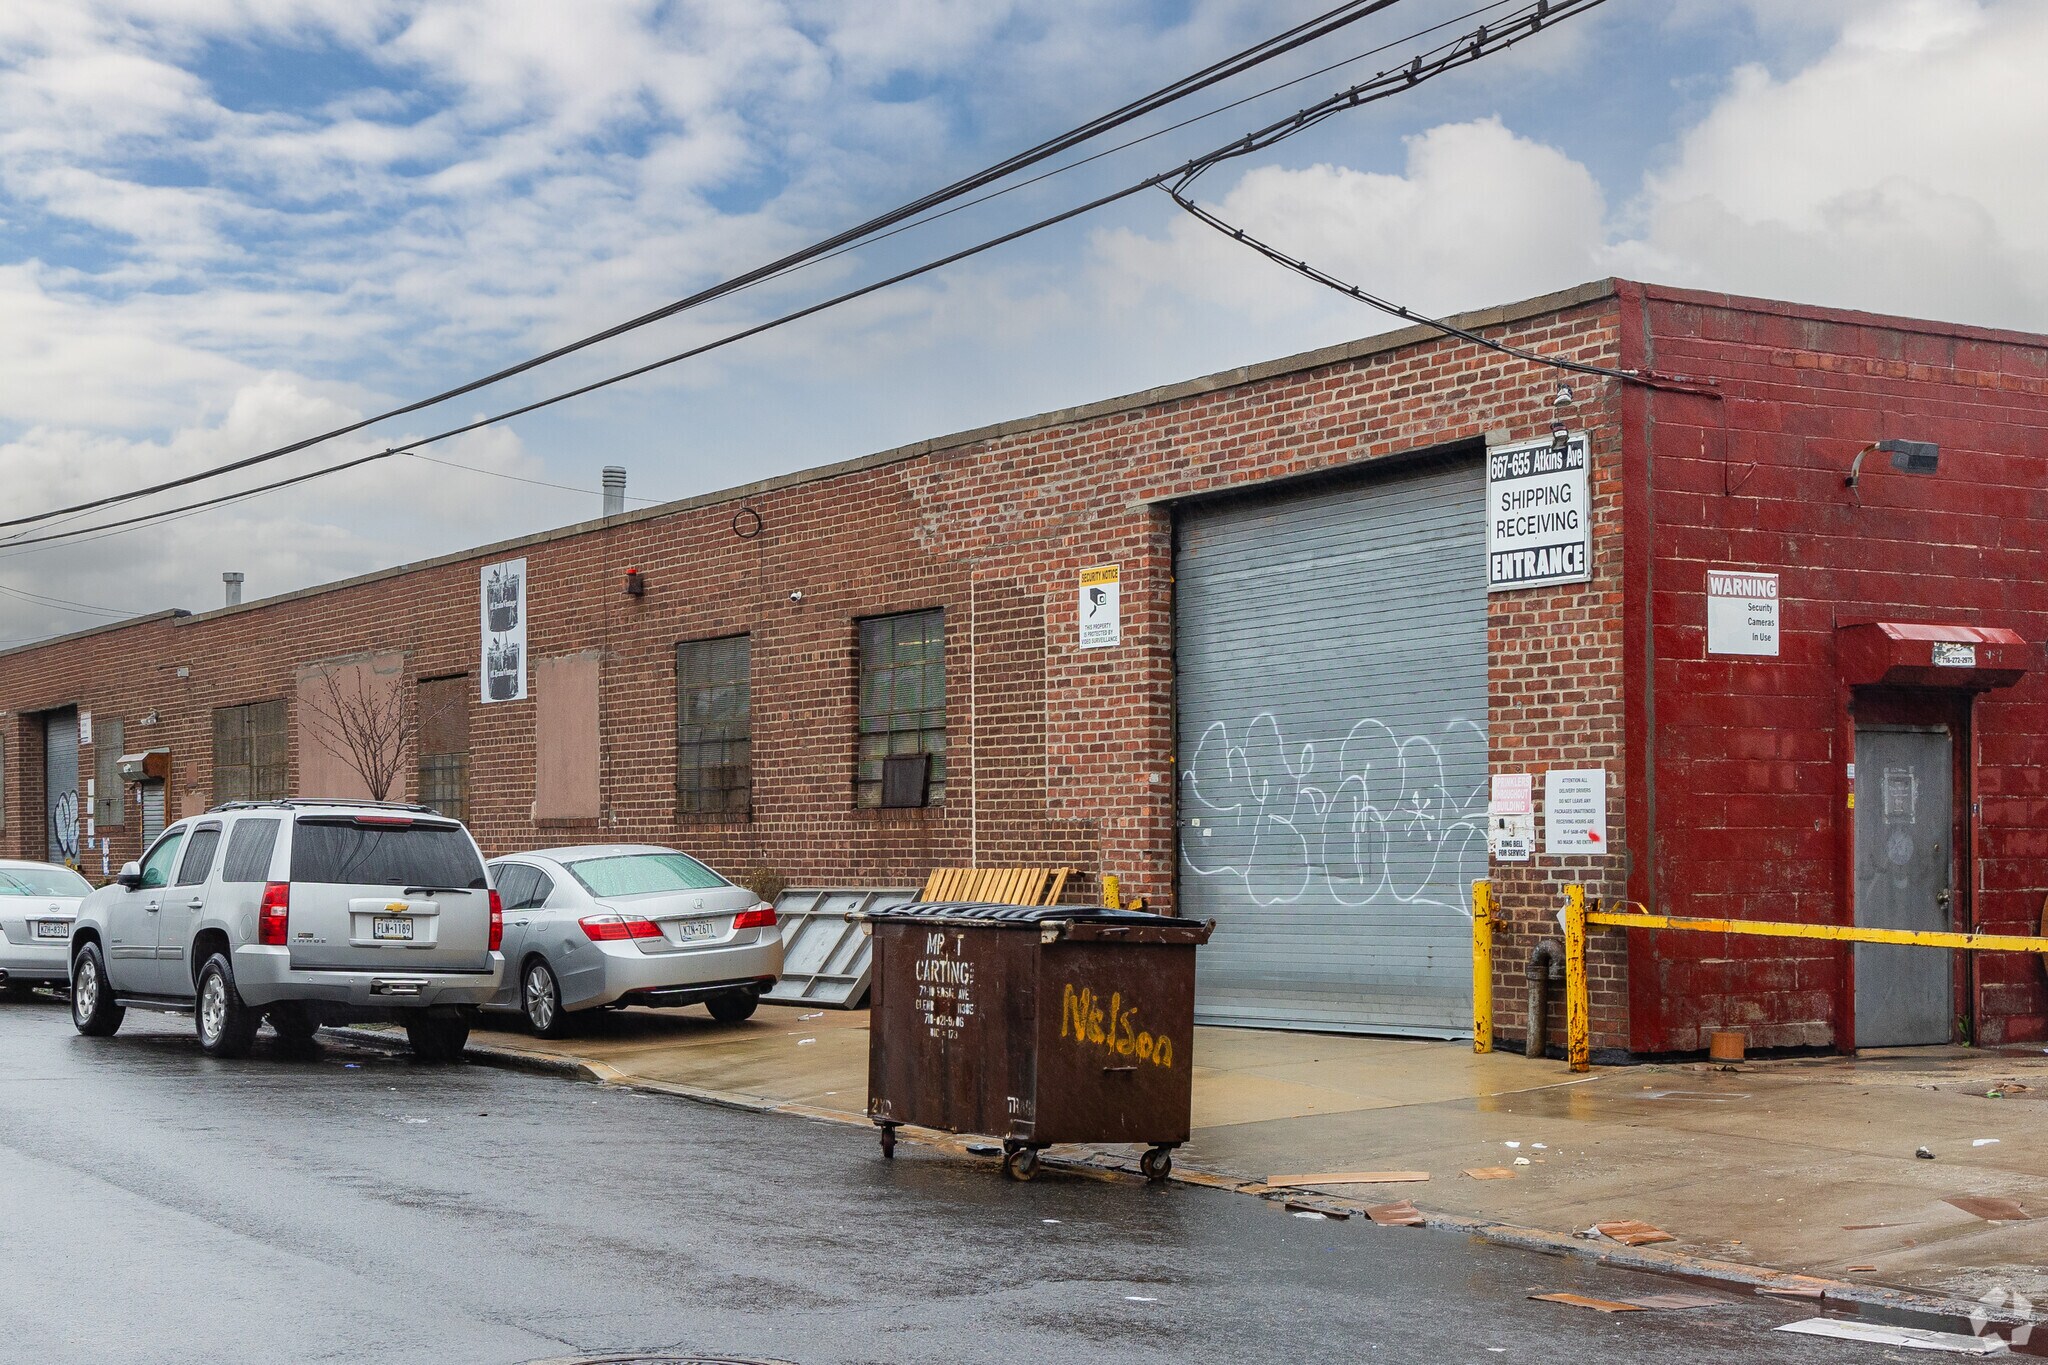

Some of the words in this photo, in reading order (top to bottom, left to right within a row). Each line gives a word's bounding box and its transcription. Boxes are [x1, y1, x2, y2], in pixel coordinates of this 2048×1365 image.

[1492, 451, 1530, 480] 667-655
[1534, 448, 1563, 472] Atkins
[1566, 445, 1583, 468] Ave
[1501, 483, 1571, 512] SHIPPING
[1496, 510, 1578, 539] RECEIVING
[1492, 544, 1584, 581] ENTRANCE
[1082, 572, 1101, 583] SECURITY
[1102, 569, 1118, 579] NOTICE
[1710, 577, 1776, 598] WARNING
[1748, 603, 1772, 613] Security
[1748, 618, 1774, 626] Cameras
[1752, 633, 1758, 641] In
[1760, 633, 1772, 642] Use
[957, 934, 964, 956] T
[916, 960, 969, 985] CARTING
[958, 989, 969, 1000] AVE
